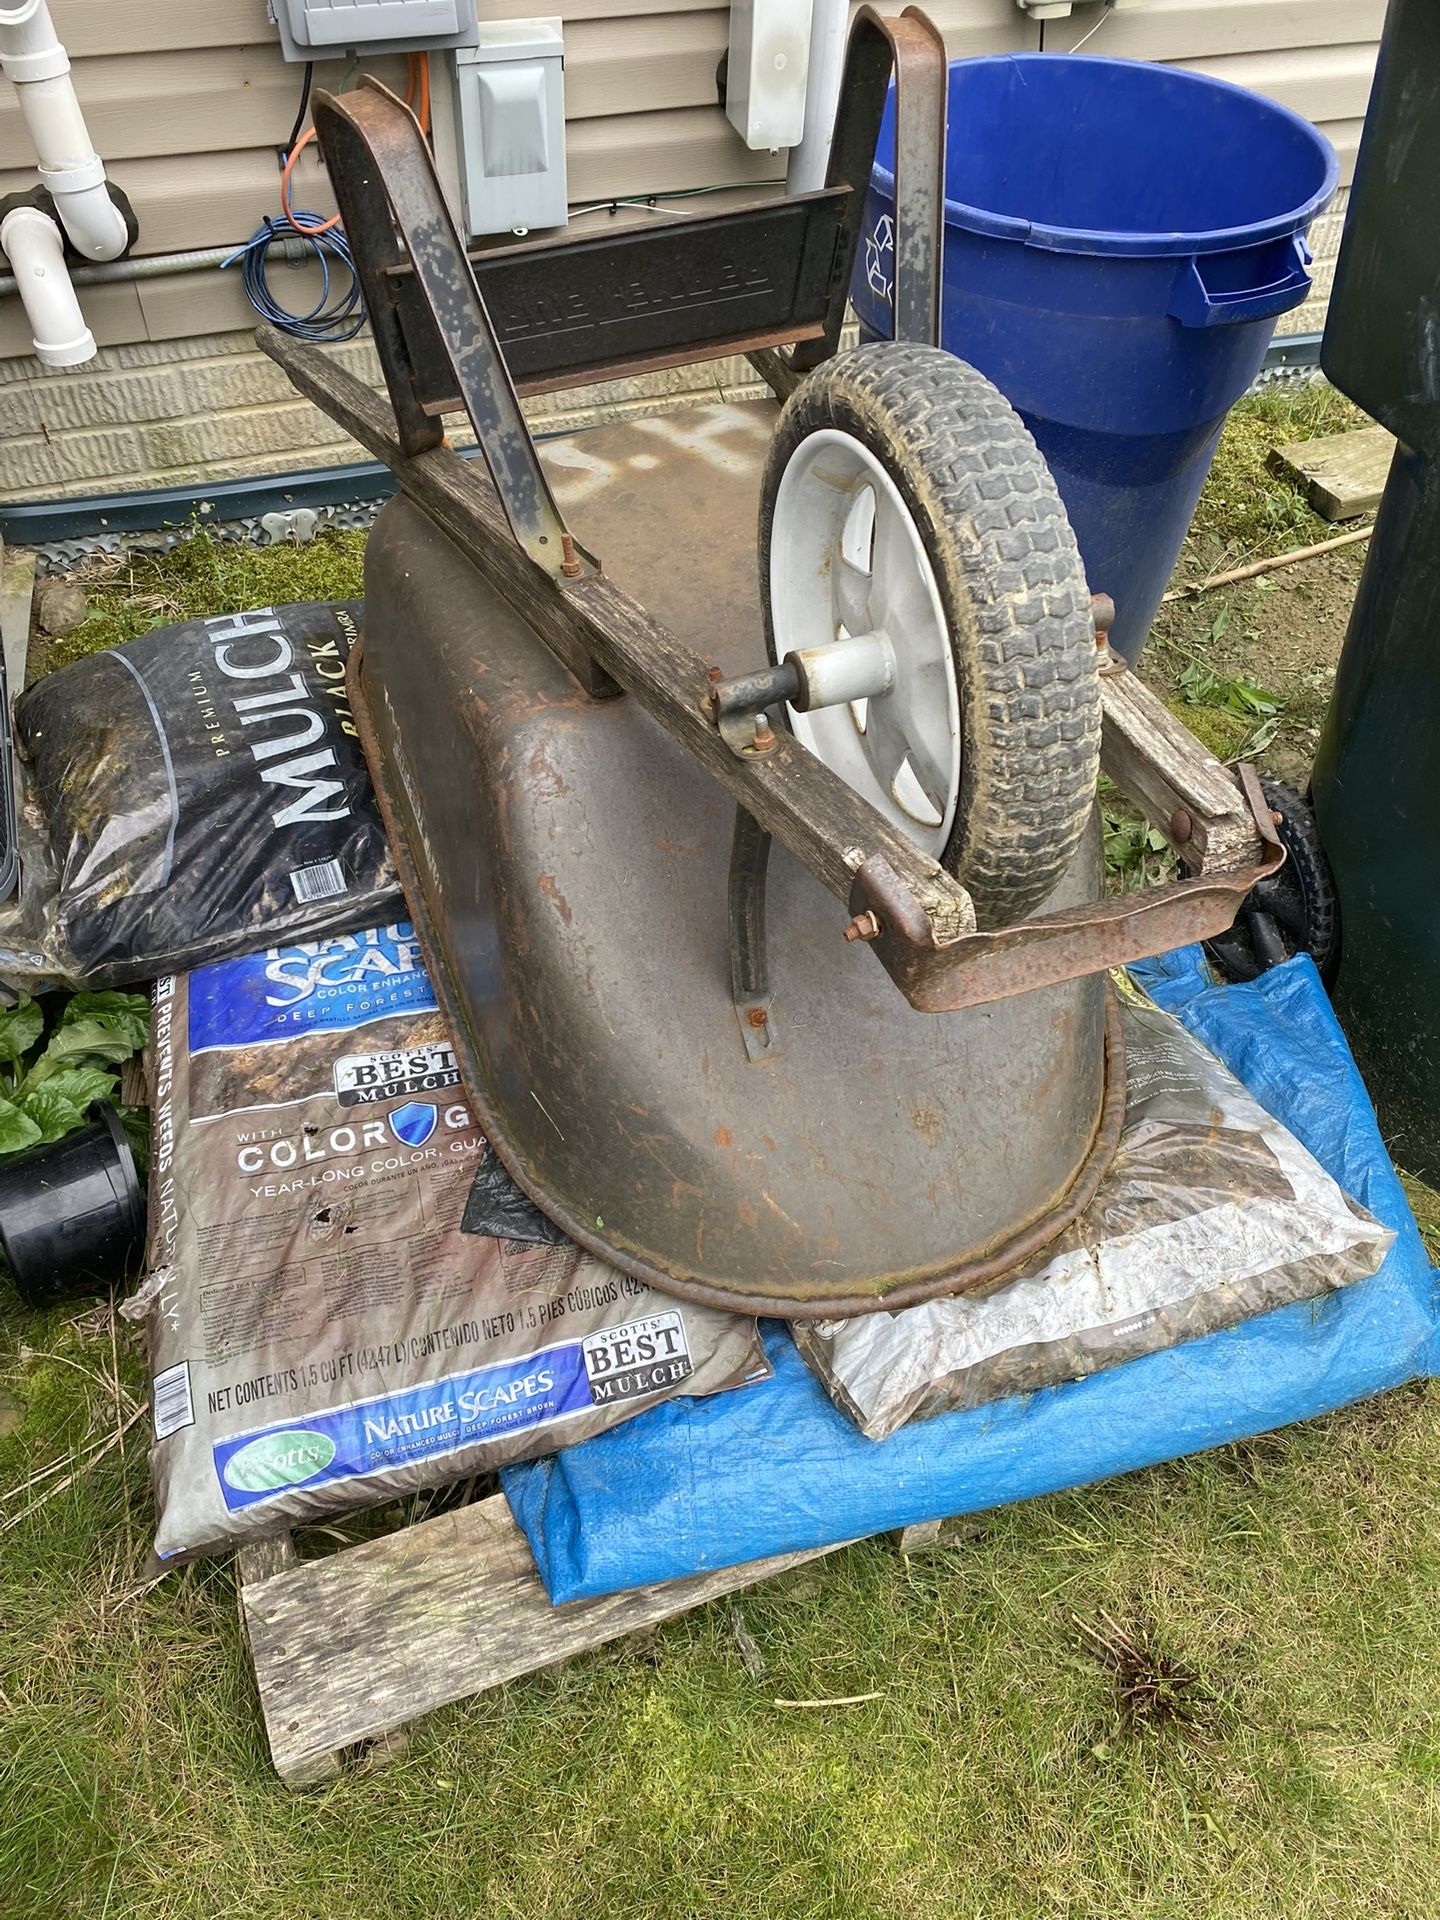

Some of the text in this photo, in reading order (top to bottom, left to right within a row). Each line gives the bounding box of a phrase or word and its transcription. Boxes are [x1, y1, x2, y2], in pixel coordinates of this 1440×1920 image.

[188, 670, 230, 758] PREMIUM
[204, 606, 351, 828] MULCH
[265, 943, 424, 1007] SCAP
[317, 970, 429, 1000] COLOR ENHANC
[277, 985, 427, 1024] DEEP FOREST
[157, 1002, 173, 1097] PREVENTS
[352, 1050, 454, 1087] BEST
[357, 1072, 459, 1102] MULCH
[158, 1098, 174, 1172] WEEDS
[237, 1128, 282, 1142] WITH
[238, 1105, 470, 1172] COLOR G
[250, 1136, 487, 1198] YEAR-LONG COLOR, GUA
[207, 1387, 231, 1414] NET
[235, 1369, 298, 1406] CONTENTS
[300, 1364, 318, 1388] 1.5
[320, 1359, 337, 1383] CU
[339, 1353, 353, 1378] FT
[482, 1312, 515, 1341] NETO
[518, 1307, 537, 1331] 1.5
[539, 1296, 566, 1325] PIES
[567, 1281, 619, 1313] CÚBICOS
[587, 1326, 680, 1376] BEST
[593, 1361, 687, 1401] MULCH
[466, 1421, 488, 1433] DEEP
[490, 1410, 523, 1425] FOREST
